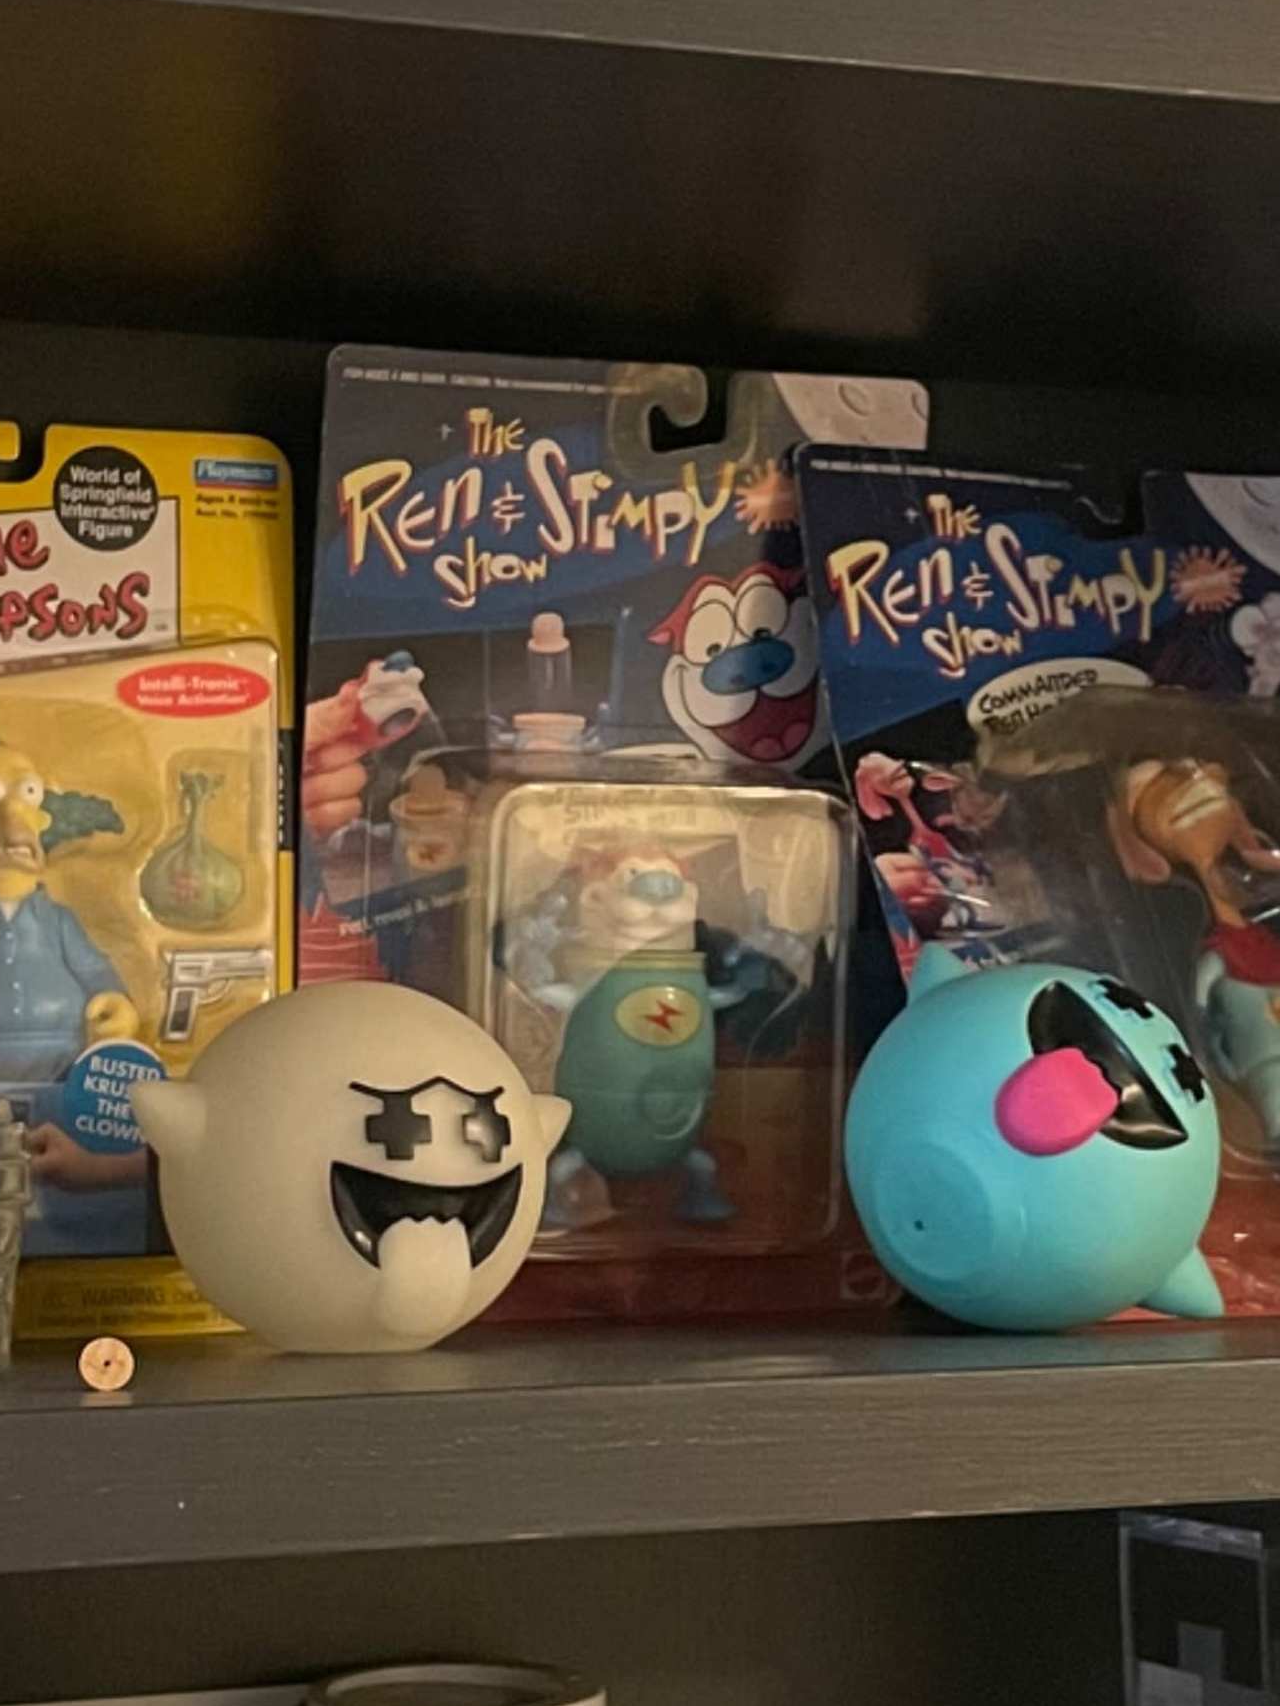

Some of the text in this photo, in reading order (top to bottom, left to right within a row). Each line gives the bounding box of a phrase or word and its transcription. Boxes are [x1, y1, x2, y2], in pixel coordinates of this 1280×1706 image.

[70, 466, 141, 484] World of
[60, 482, 152, 505] Springfield
[60, 503, 151, 521] Interactive
[491, 480, 525, 535] &
[78, 519, 134, 542] Figure
[960, 563, 993, 609] &
[978, 669, 1098, 714] COMMANDER
[89, 1055, 161, 1082] BUSTED
[96, 1098, 131, 1118] THE
